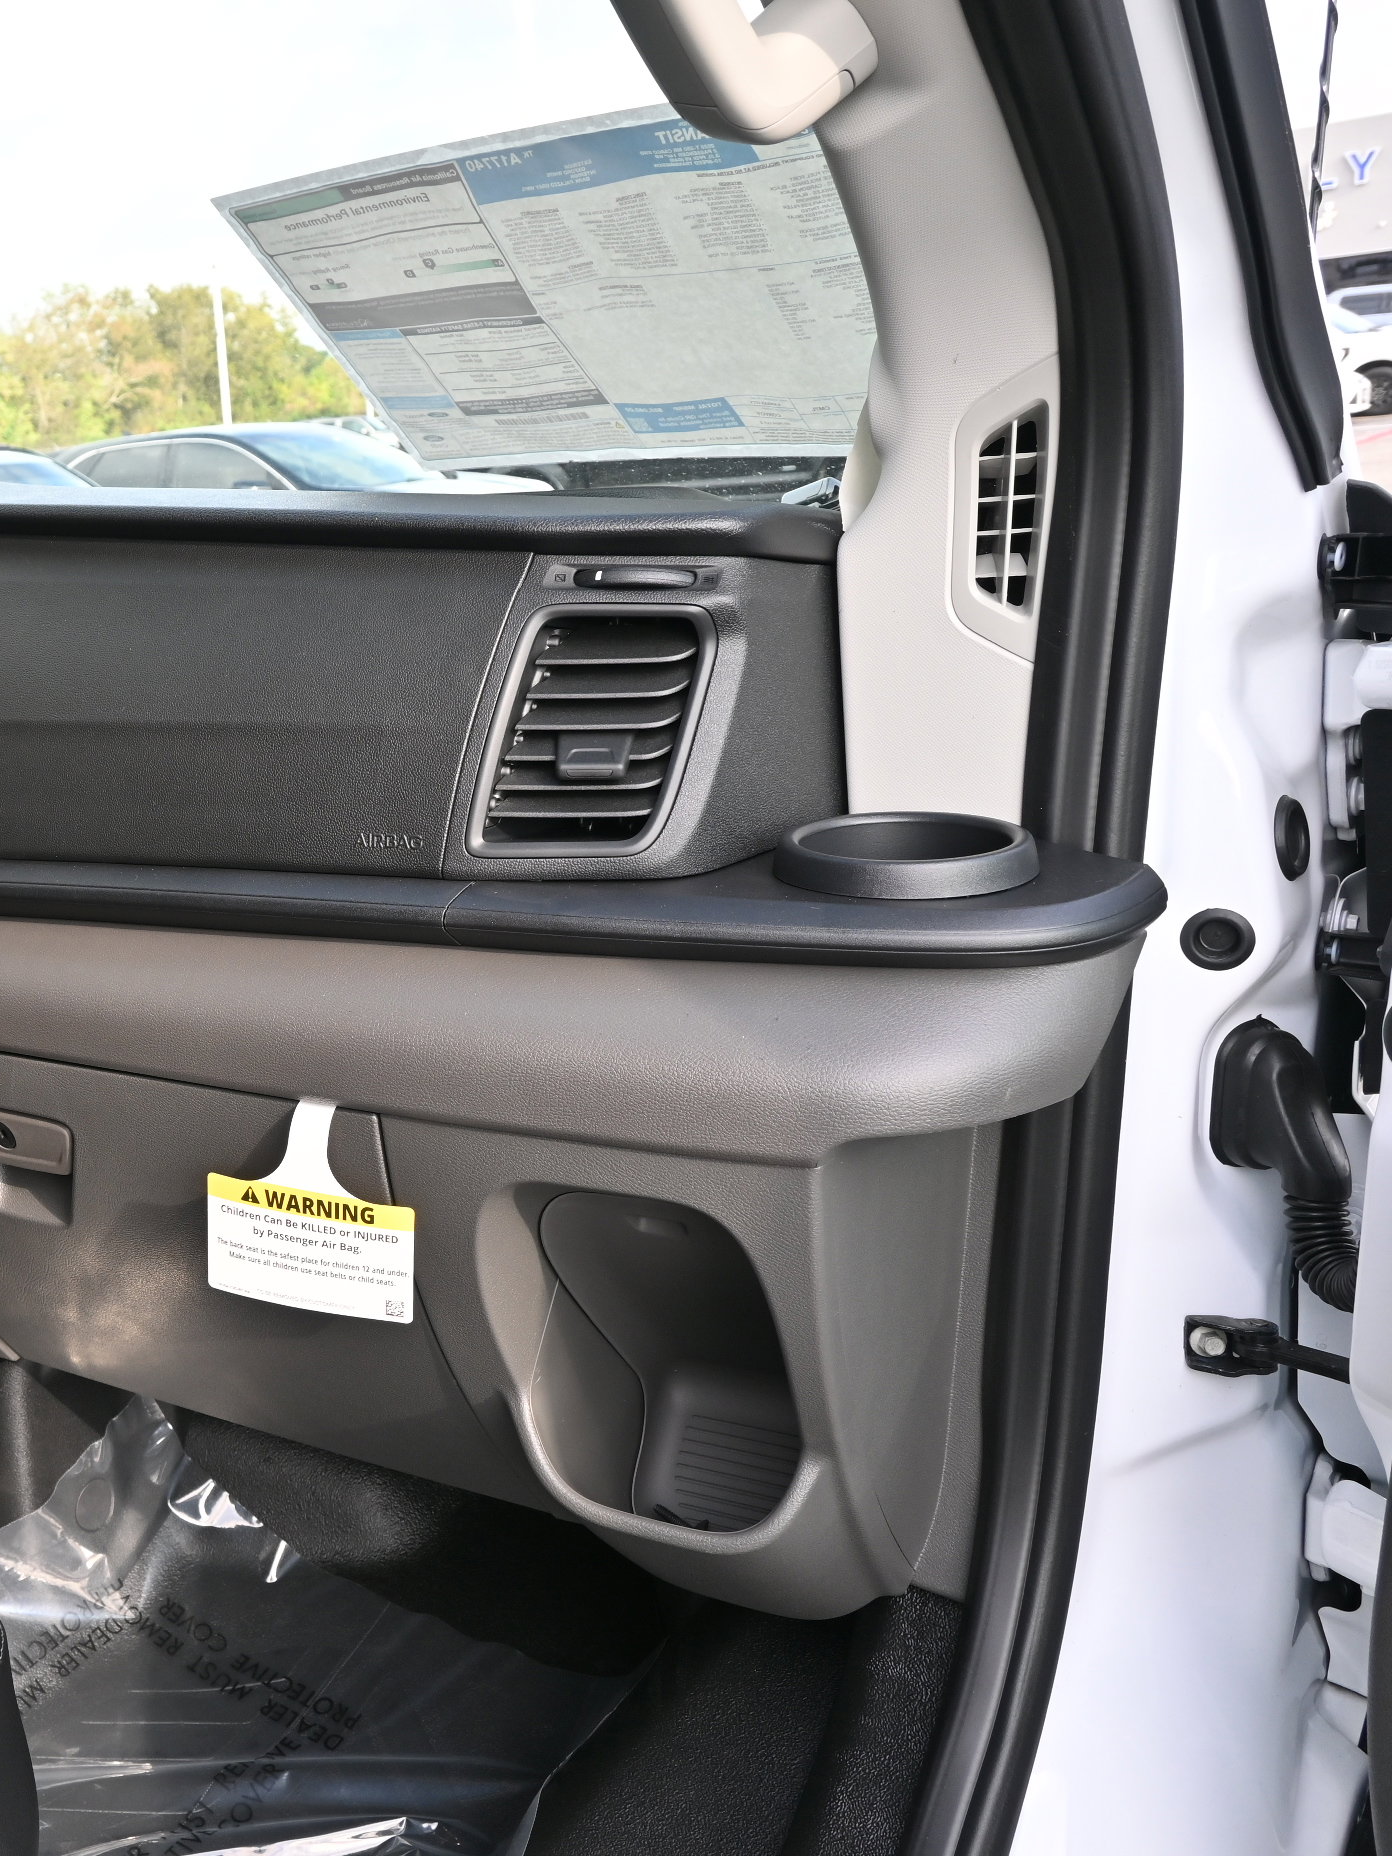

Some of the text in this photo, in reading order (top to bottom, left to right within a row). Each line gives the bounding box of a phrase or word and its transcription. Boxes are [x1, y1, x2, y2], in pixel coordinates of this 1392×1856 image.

[357, 833, 423, 849] AIRBAG
[221, 1204, 399, 1244] Children Can Be KILLED or INJURED
[265, 1189, 375, 1224] WARNING
[217, 1236, 228, 1246] The
[230, 1240, 244, 1249] back
[246, 1244, 259, 1254] seat
[267, 1249, 278, 1258] the
[279, 1252, 299, 1262] safest
[301, 1255, 319, 1265] place
[320, 1259, 330, 1267] for
[332, 1261, 360, 1271] children
[362, 1265, 370, 1273] 12
[387, 1269, 409, 1278] under.
[253, 1226, 362, 1255] by Passenger Air Bag.
[229, 1250, 246, 1261] Make
[248, 1255, 261, 1264] sure
[263, 1258, 271, 1267] all
[272, 1261, 299, 1272] children
[300, 1266, 312, 1275] use
[314, 1268, 328, 1277] seat
[330, 1271, 347, 1280] belts
[357, 1275, 375, 1284] child
[376, 1279, 397, 1287] seats.
[55, 1617, 124, 1678] DEALER
[159, 1596, 362, 1732] PROTECTIVE COVER
[187, 1654, 255, 1700] MUST
[259, 1699, 344, 1751] DEALER
